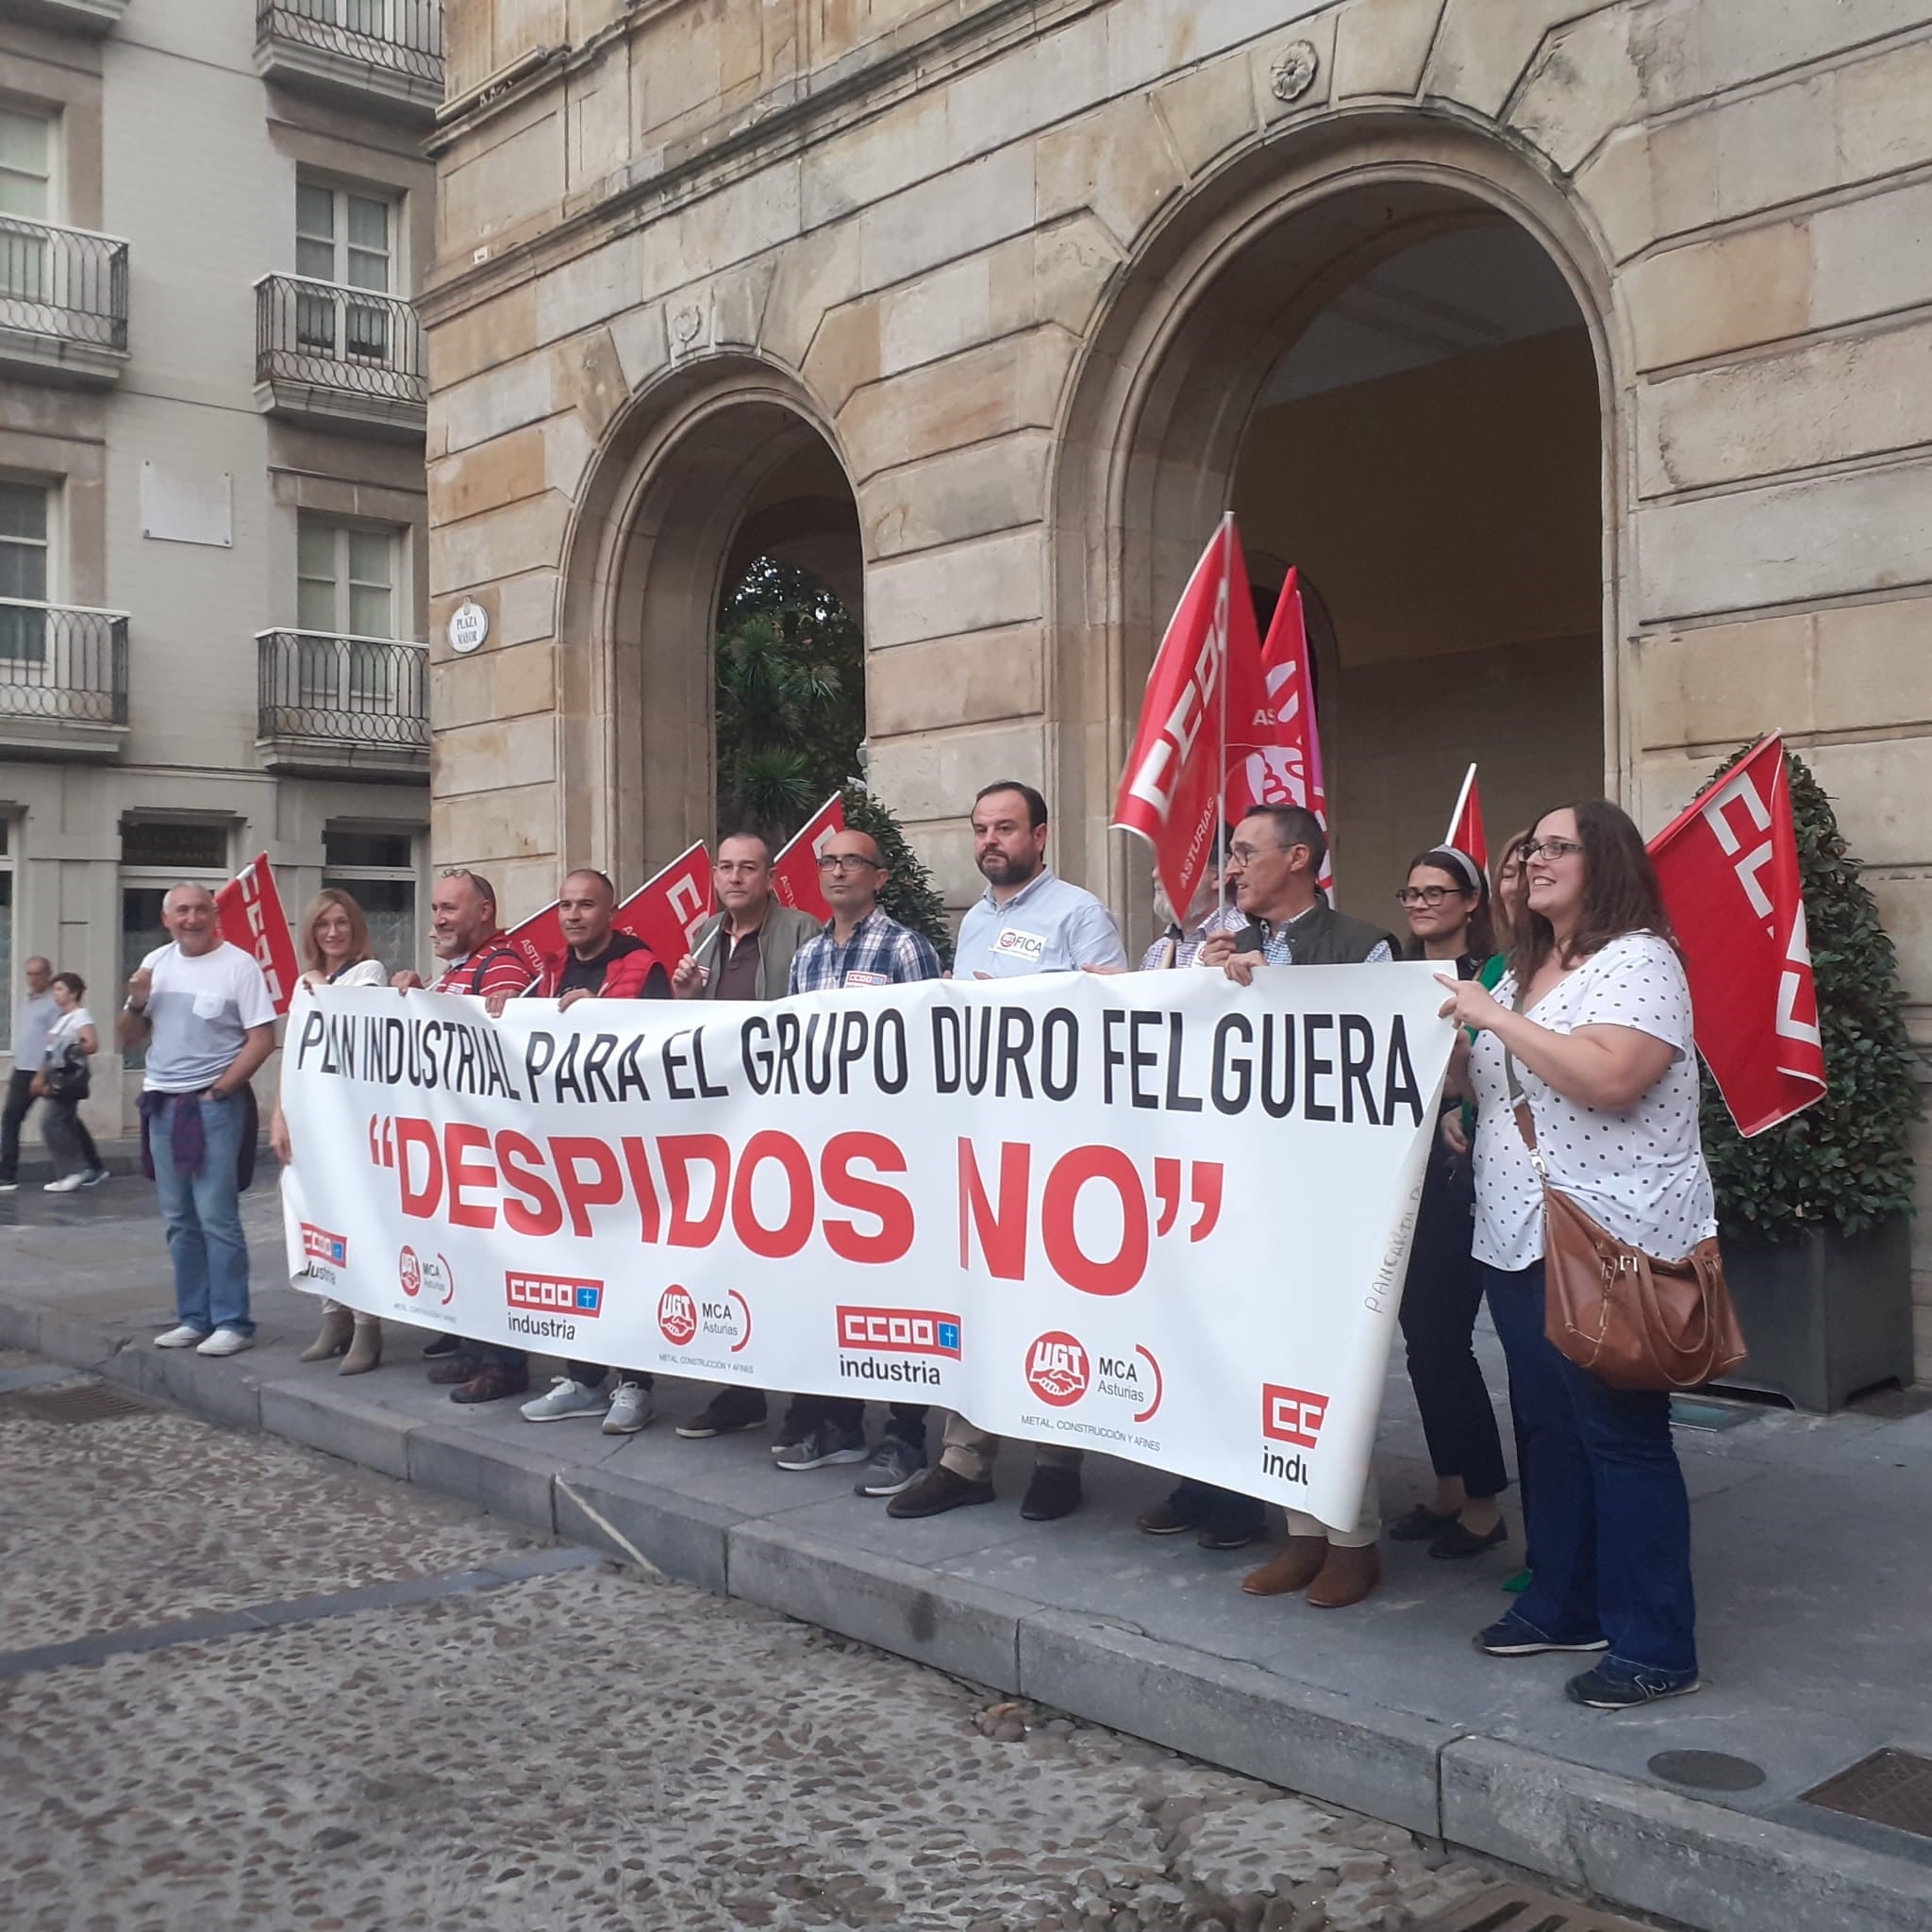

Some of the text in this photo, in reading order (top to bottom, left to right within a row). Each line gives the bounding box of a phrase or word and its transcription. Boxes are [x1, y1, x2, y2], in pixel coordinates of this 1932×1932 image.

[1180, 796, 1214, 889] ASTURIAS
[1016, 937, 1042, 953] FICA
[363, 1015, 522, 1101] INDUSTRIAL
[525, 1030, 651, 1104] PARA
[661, 1024, 730, 1101] EL
[741, 1008, 908, 1097] GRUPO
[932, 1006, 1079, 1102] DURO
[1104, 1008, 1424, 1129] FELGUERA
[510, 1278, 574, 1307] CCOO
[662, 1293, 691, 1321] UGT
[702, 1302, 732, 1321] MCA
[508, 1311, 576, 1341] industria
[702, 1322, 739, 1337] Asturias
[844, 1314, 934, 1346] CCOO
[840, 1354, 941, 1386] industria
[1033, 1341, 1083, 1375] UGT
[1099, 1357, 1138, 1383] MCA
[1097, 1380, 1144, 1403] Asturias
[1126, 1434, 1134, 1443] Y
[1134, 1436, 1161, 1452] AFINES
